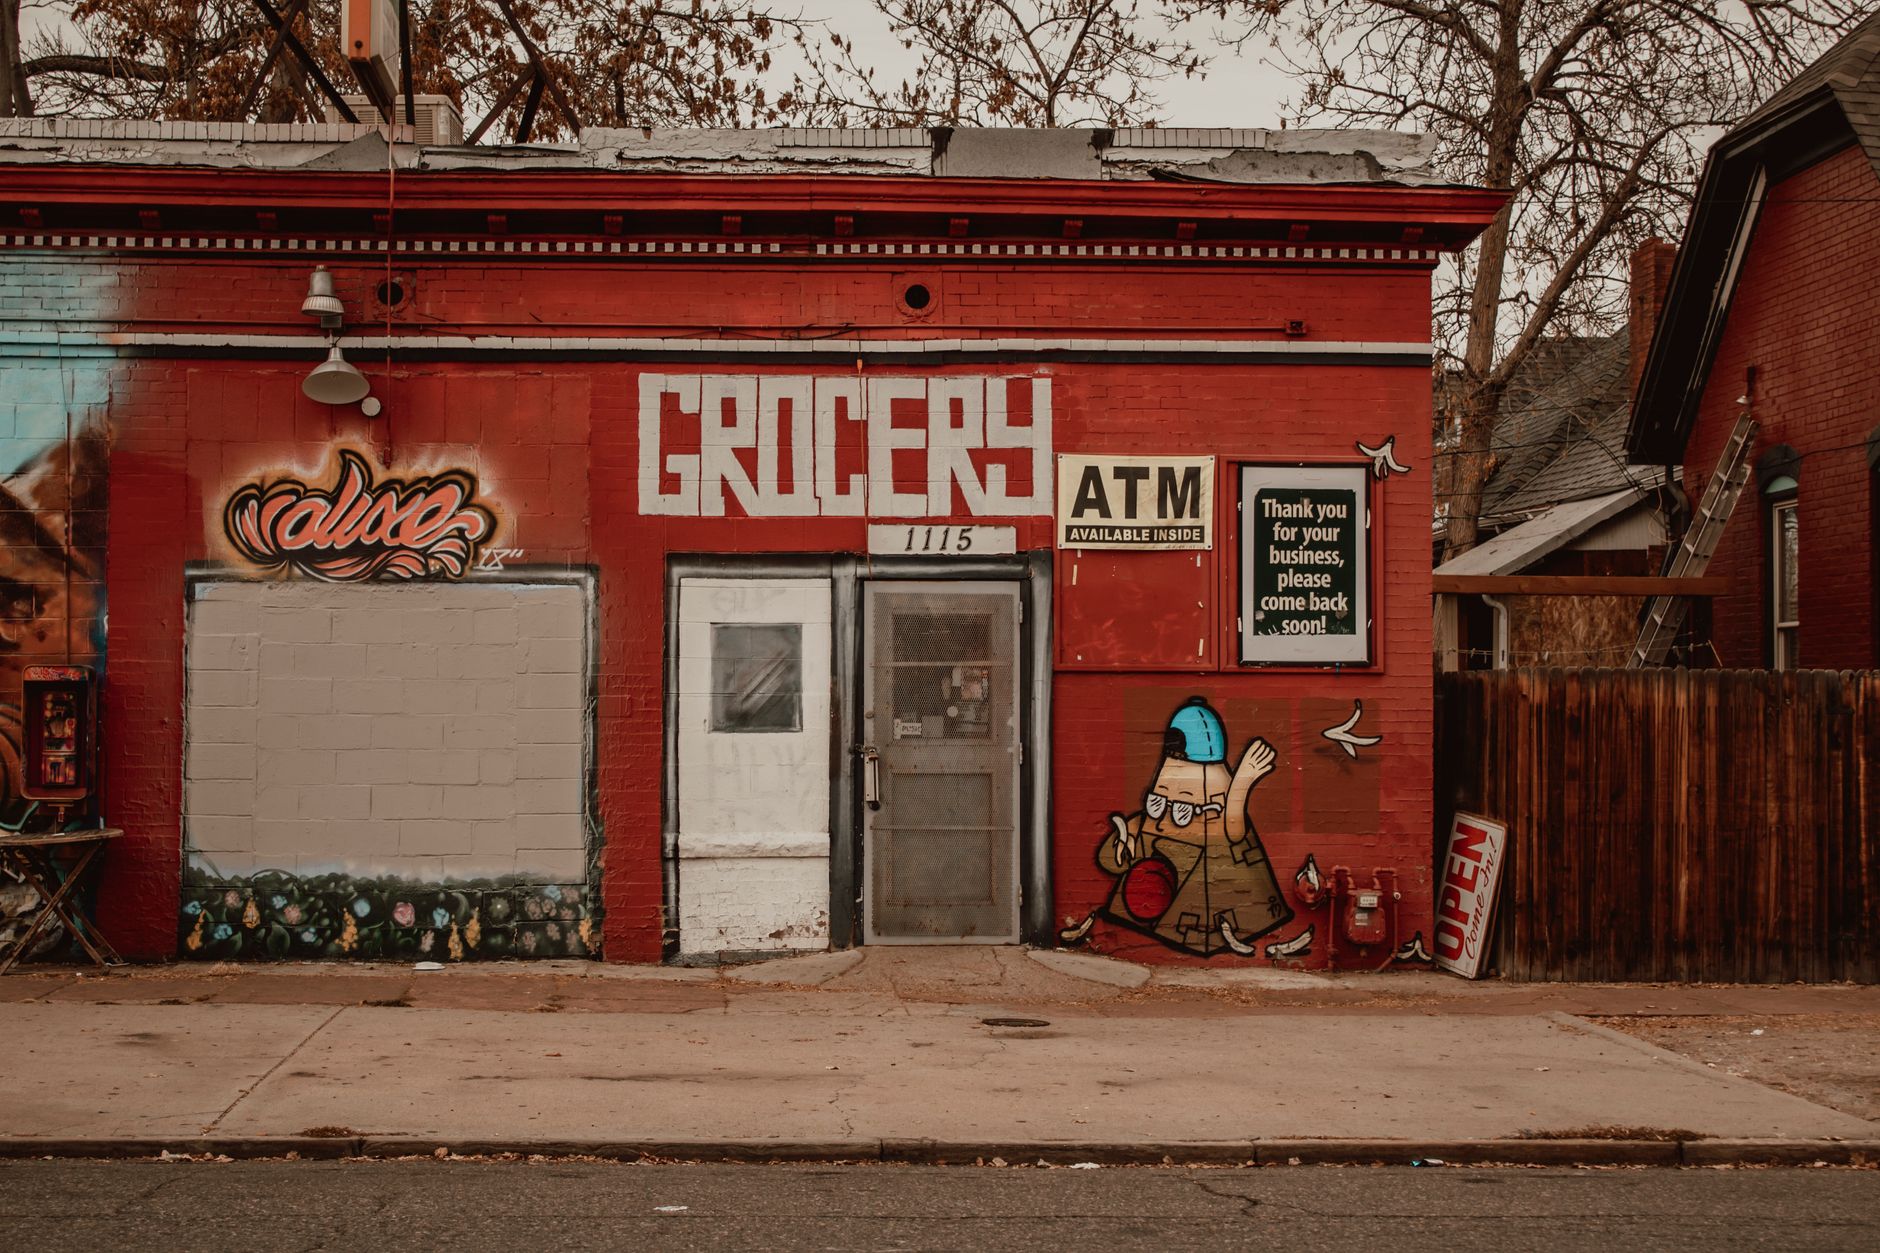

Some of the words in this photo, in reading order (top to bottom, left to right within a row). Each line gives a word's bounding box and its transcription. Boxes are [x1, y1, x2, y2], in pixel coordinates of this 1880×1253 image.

[638, 373, 1053, 517] GROCERY
[1071, 465, 1201, 519] ATM
[1262, 498, 1314, 518] Thank
[1316, 503, 1347, 523] you
[905, 526, 973, 552] 1115
[1070, 528, 1150, 541] AVAILABLE
[1153, 528, 1201, 541] INSIDE
[1272, 521, 1298, 541] for
[1302, 527, 1340, 546] your
[1269, 544, 1345, 568] business,
[1277, 568, 1332, 592] please
[1260, 596, 1306, 611] come
[1309, 591, 1348, 611] back
[1281, 615, 1327, 634] soon!
[1433, 821, 1488, 961] OPEN
[1465, 892, 1485, 960] Come
[1480, 835, 1498, 887] In!
